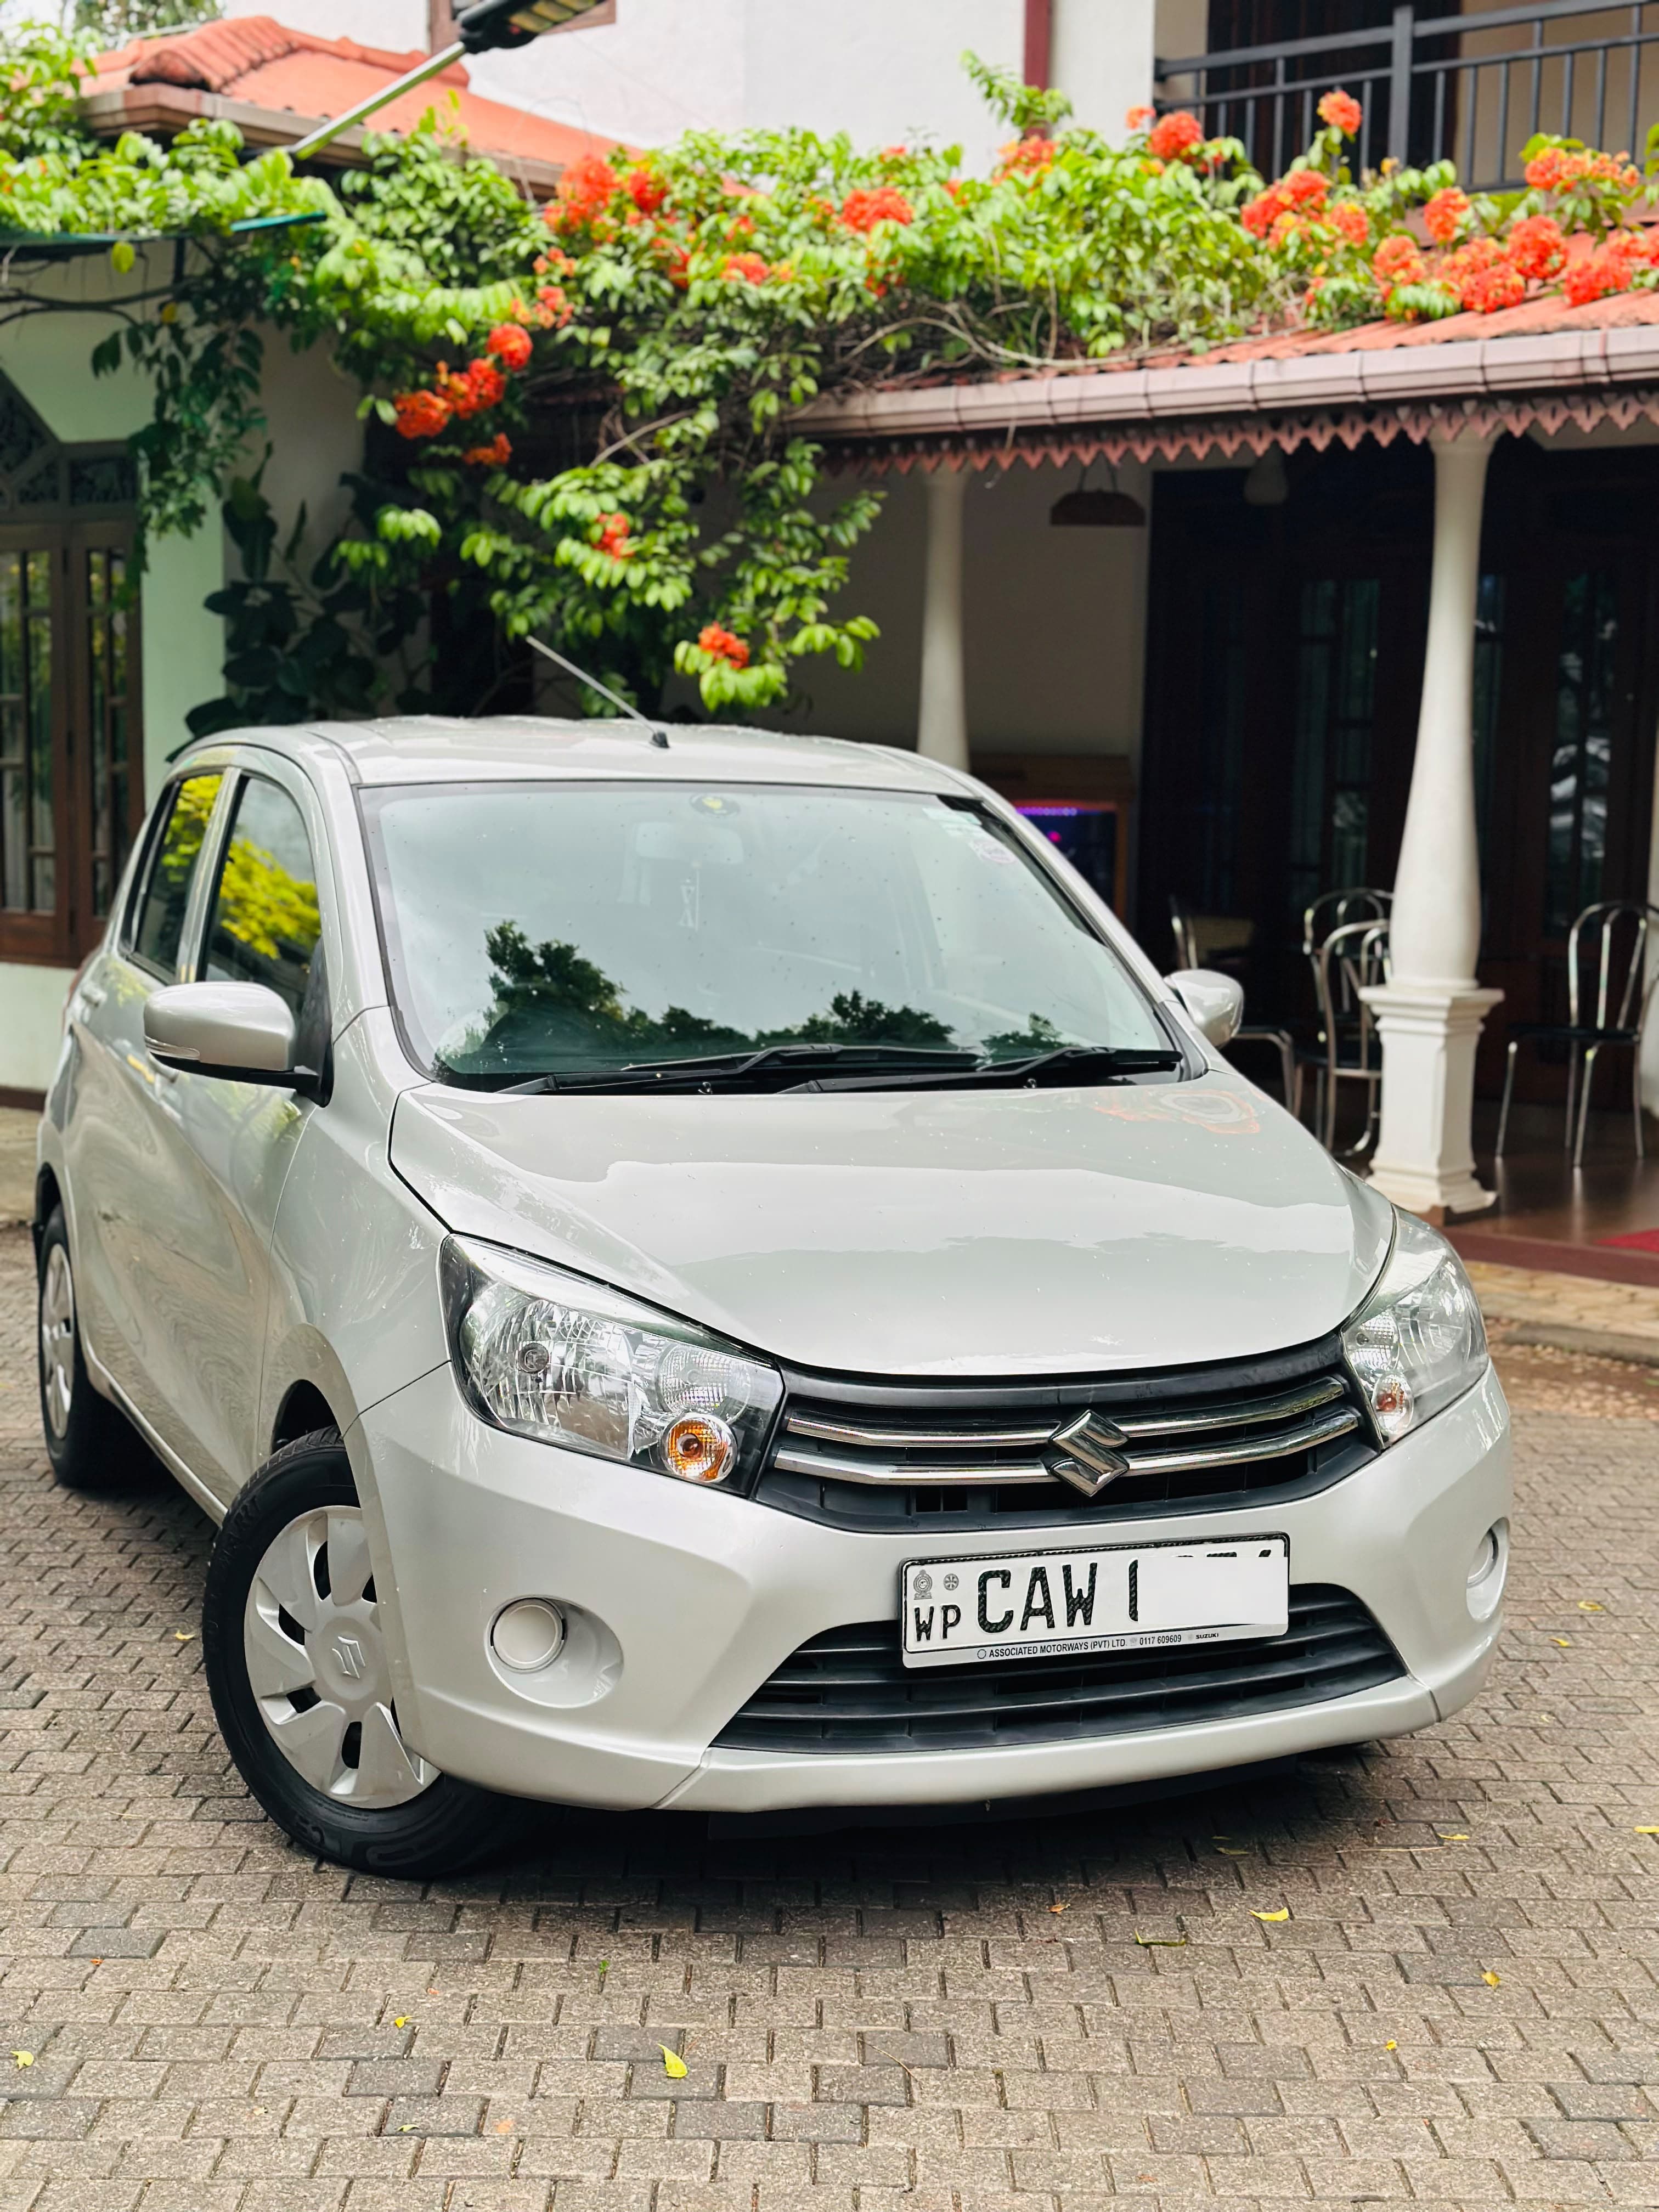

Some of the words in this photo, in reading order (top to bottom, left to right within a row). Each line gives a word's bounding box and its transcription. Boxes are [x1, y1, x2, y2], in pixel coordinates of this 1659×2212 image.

[978, 1562, 1098, 1633] CAW
[915, 1604, 961, 1641] WP
[989, 1646, 1037, 1657] ASSOCIATED
[1040, 1643, 1088, 1654] MOTORWAYS
[1091, 1640, 1110, 1650] (PVT)
[1139, 1637, 1155, 1645] 0117
[1158, 1634, 1181, 1644] 609609
